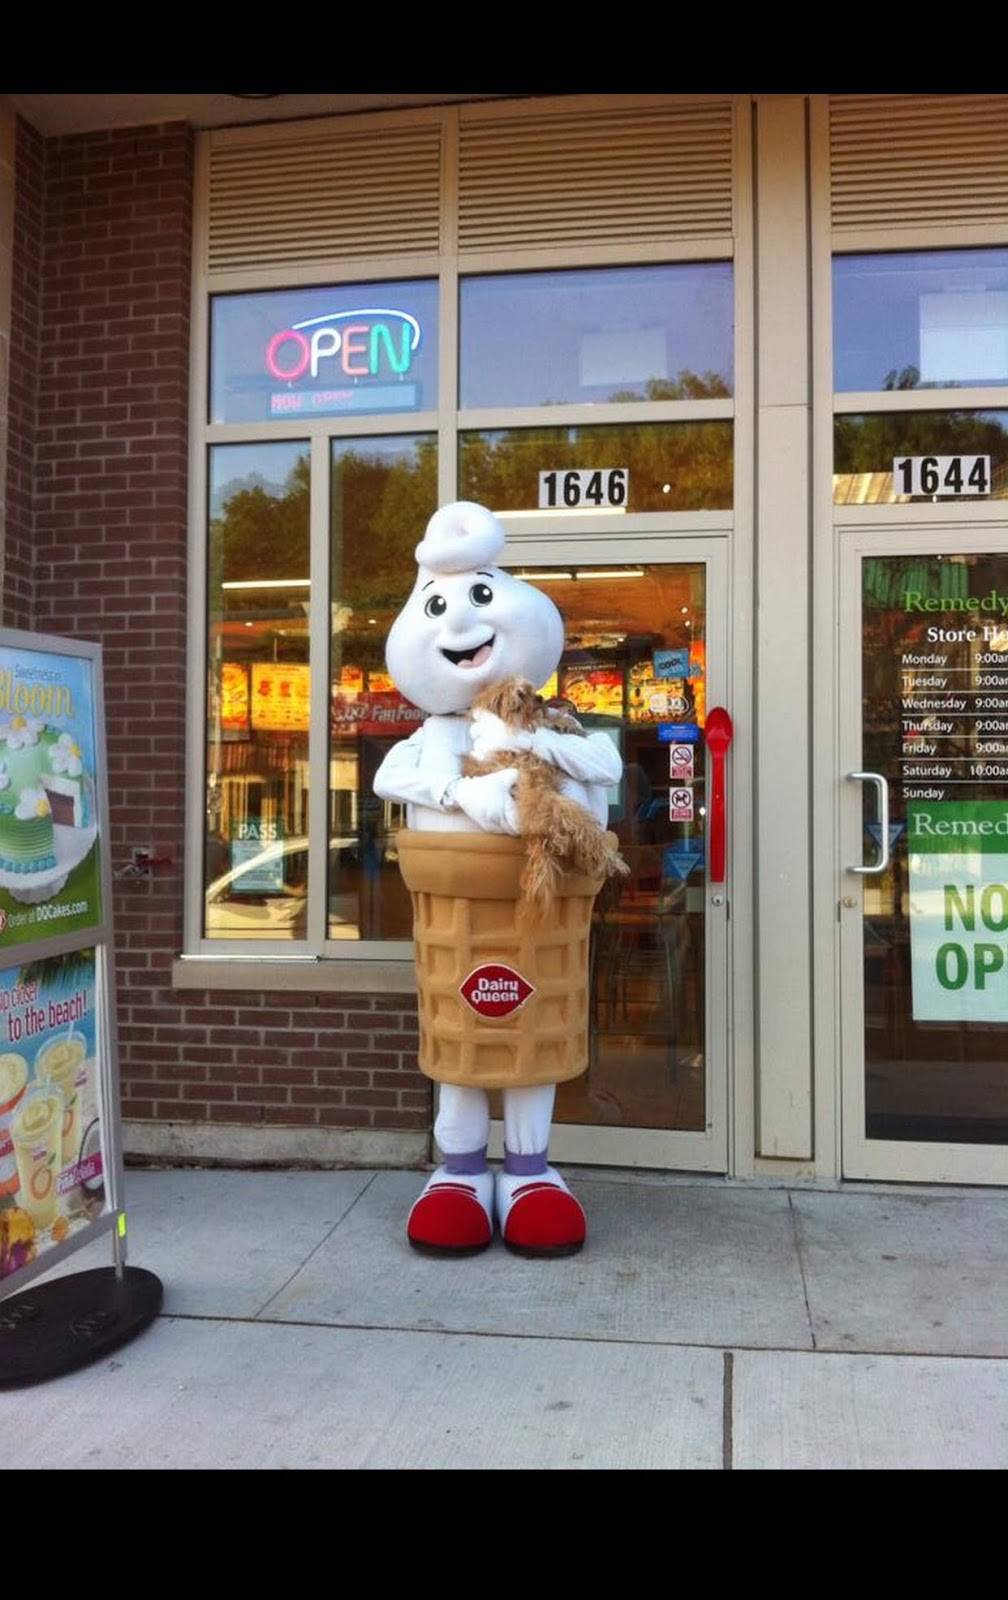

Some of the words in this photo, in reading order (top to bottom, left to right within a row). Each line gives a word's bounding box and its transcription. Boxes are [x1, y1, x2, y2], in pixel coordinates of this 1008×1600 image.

[267, 323, 412, 381] OPEN
[898, 457, 988, 494] 1644
[543, 469, 626, 507] 1646
[904, 590, 1008, 616] Remedy
[927, 627, 976, 643] Store
[902, 654, 948, 667] Monday
[902, 676, 948, 688] Tuesday
[902, 698, 967, 711] Wednesday
[902, 720, 954, 733] Thursday
[902, 743, 937, 756] Friday
[903, 765, 952, 778] Saturday
[903, 787, 945, 800] Sunday
[238, 823, 278, 840] PASS
[478, 977, 519, 992] Dairy
[471, 990, 519, 1004] Queen
[9, 1012, 21, 1042] to
[25, 1006, 45, 1036] the
[49, 990, 87, 1028] beach!
